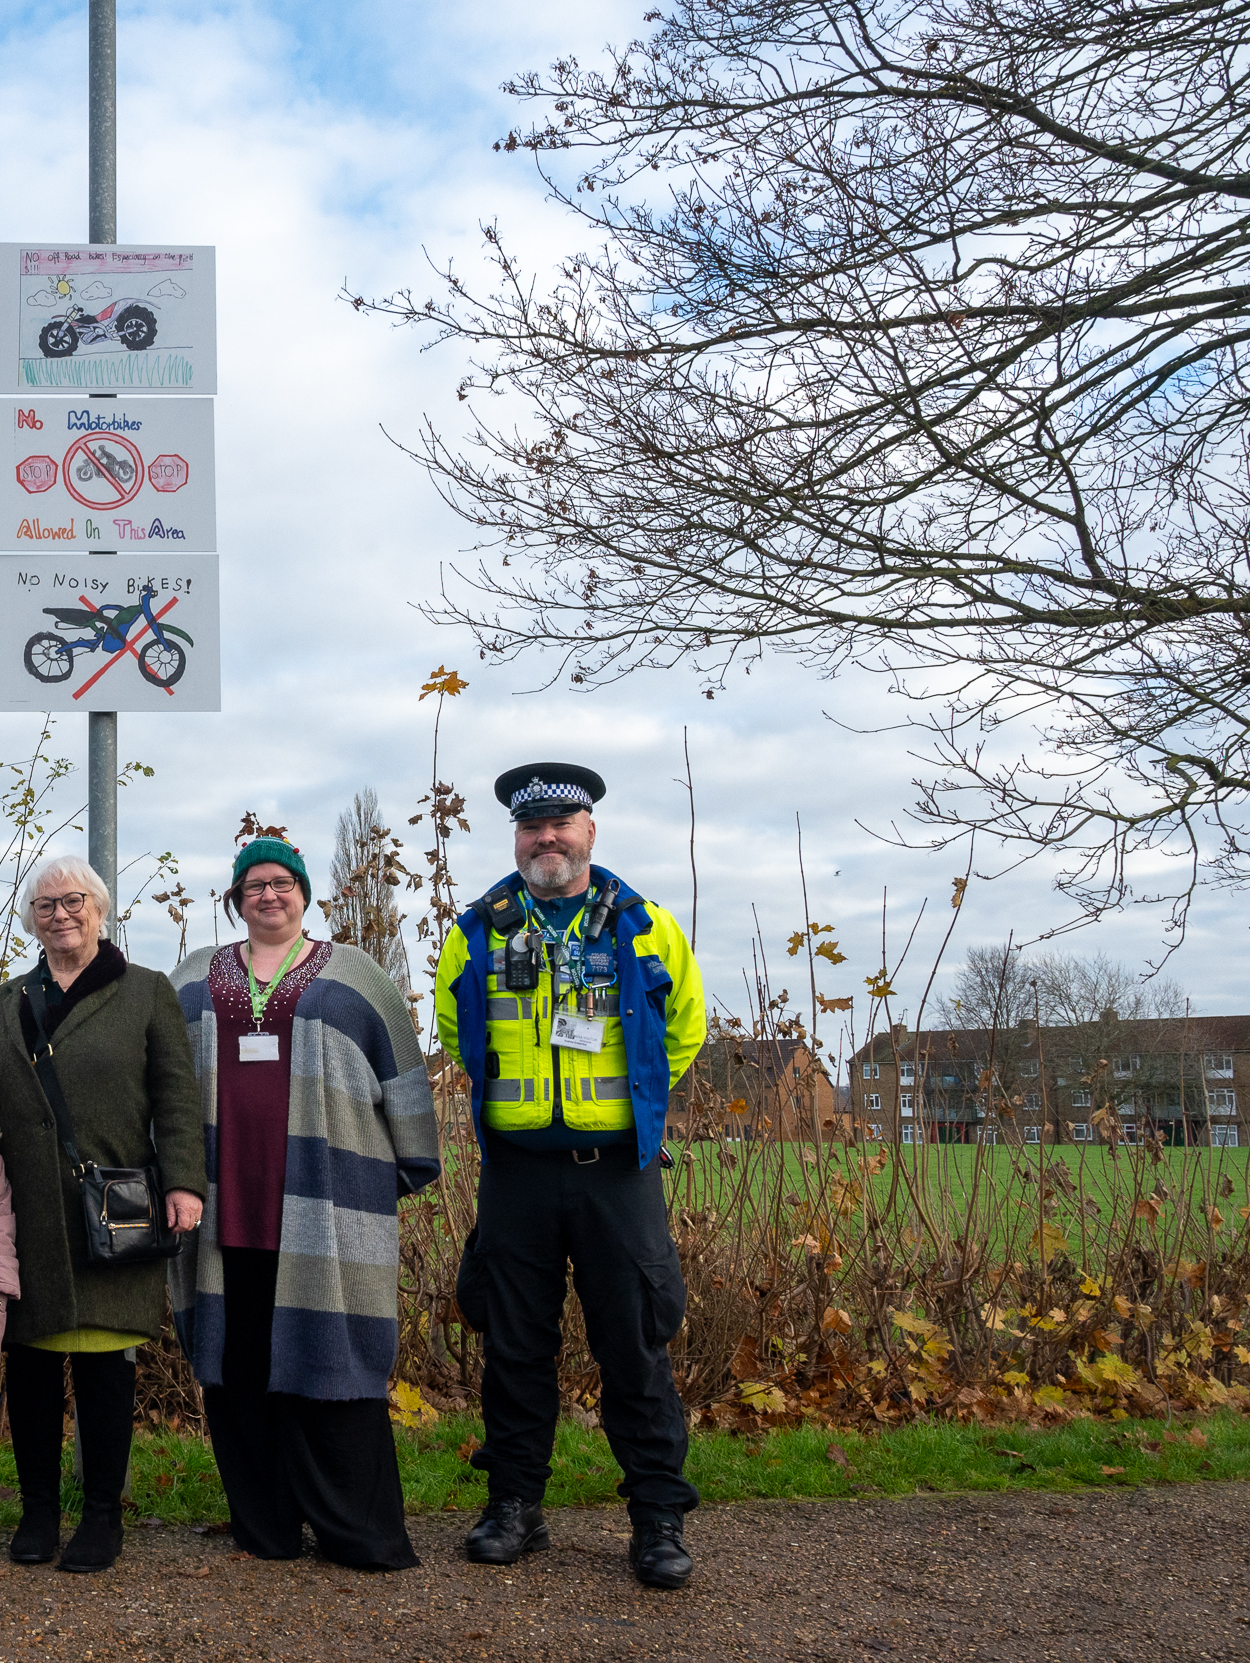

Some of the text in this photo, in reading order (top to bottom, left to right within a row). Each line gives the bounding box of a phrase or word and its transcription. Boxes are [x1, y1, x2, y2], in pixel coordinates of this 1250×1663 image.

[25, 252, 40, 263] NO
[17, 409, 143, 431] No Motorbikes
[22, 465, 52, 479] STOP
[151, 463, 182, 479] STOP
[16, 518, 186, 541] Allowed On This Area
[17, 571, 40, 586] NO
[591, 965, 608, 973] 7173
